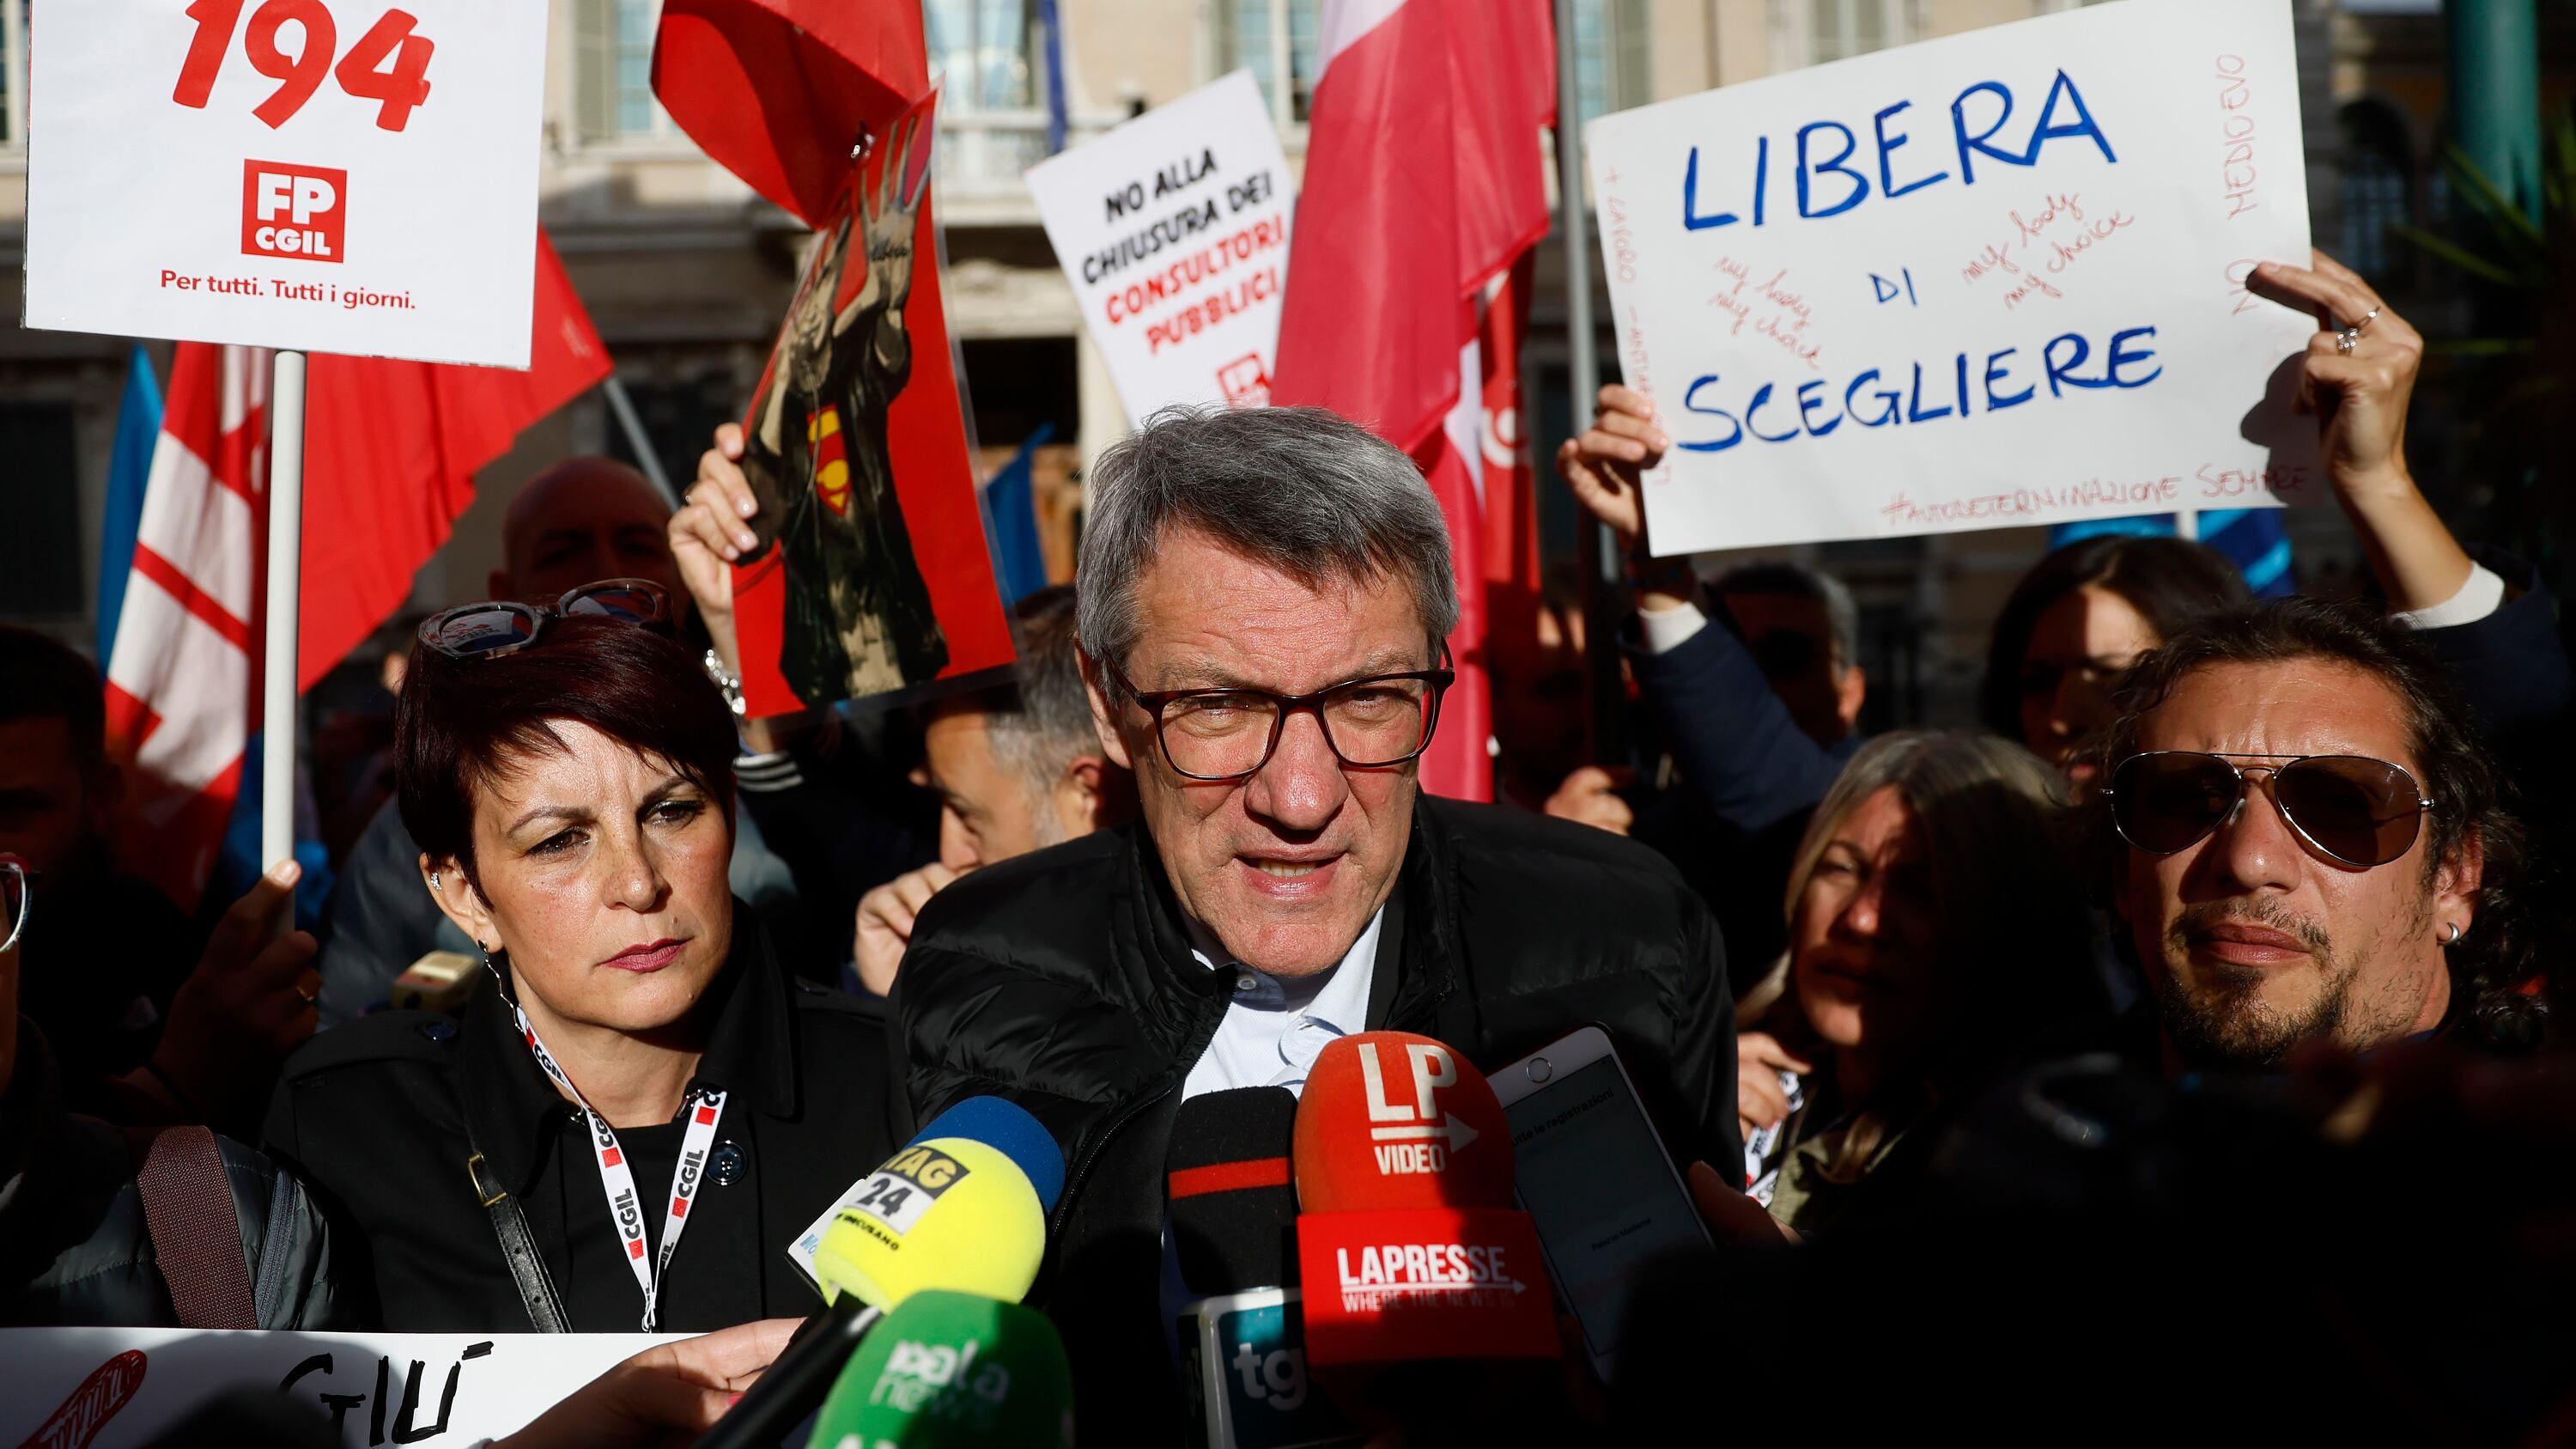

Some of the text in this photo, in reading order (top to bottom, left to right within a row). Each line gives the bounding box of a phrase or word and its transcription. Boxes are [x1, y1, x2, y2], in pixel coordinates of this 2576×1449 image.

[173, 0, 434, 131] 194
[1683, 69, 2117, 231] LIBERA
[257, 172, 336, 225] FP
[1106, 148, 1217, 222] NO ALLA
[255, 226, 331, 256] CGIL
[1083, 170, 1273, 284] CHIUSURA DEI
[1962, 192, 2085, 284] my body
[1107, 214, 1284, 325] CONSULTORI
[1713, 257, 1749, 295] my
[1869, 267, 1918, 307] DI
[2003, 211, 2136, 310] my choice
[2225, 259, 2262, 315] NO
[161, 269, 416, 309] Per tutti. Tutti i giorni.
[1146, 267, 1279, 355] PUBBLICI
[1707, 292, 1751, 337] my
[1678, 326, 2163, 453] SCEGLIERE
[533, 1043, 566, 1084] CGIL
[1358, 1042, 1457, 1122] LP
[1512, 1129, 1534, 1147] utte
[1546, 1087, 1614, 1129] registrazioni
[677, 1148, 704, 1198] CGIL
[1374, 1144, 1445, 1175] VIDEO
[616, 1188, 641, 1240] CGIL
[855, 1177, 913, 1218] 24
[1336, 1244, 1511, 1286] LAPRESSE
[1341, 1290, 1403, 1313] WHERE
[1410, 1289, 1442, 1311] THE
[1446, 1288, 1493, 1310] NEWS
